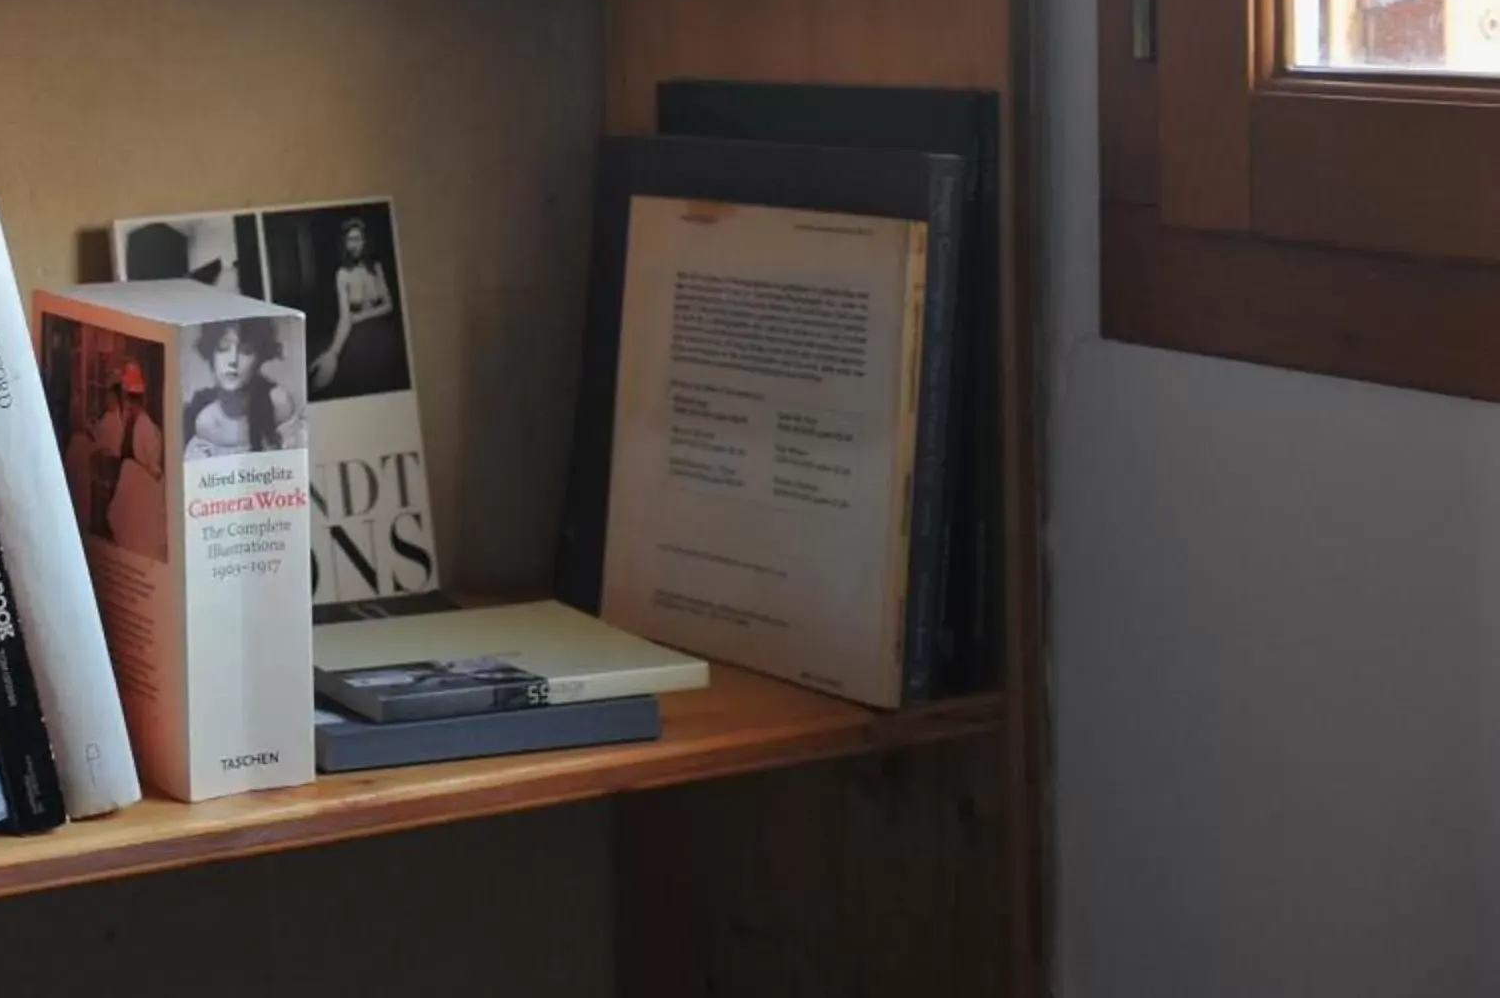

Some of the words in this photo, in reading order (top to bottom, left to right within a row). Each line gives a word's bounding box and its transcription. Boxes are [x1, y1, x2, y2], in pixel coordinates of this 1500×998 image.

[197, 472, 236, 490] Alfred
[236, 465, 294, 486] Stieglitz
[187, 496, 254, 520] Camera
[254, 487, 309, 510] Work
[201, 525, 224, 542] The
[226, 517, 293, 538] Complete
[207, 539, 287, 560] Illustrations
[219, 750, 280, 772] TASCHEN
